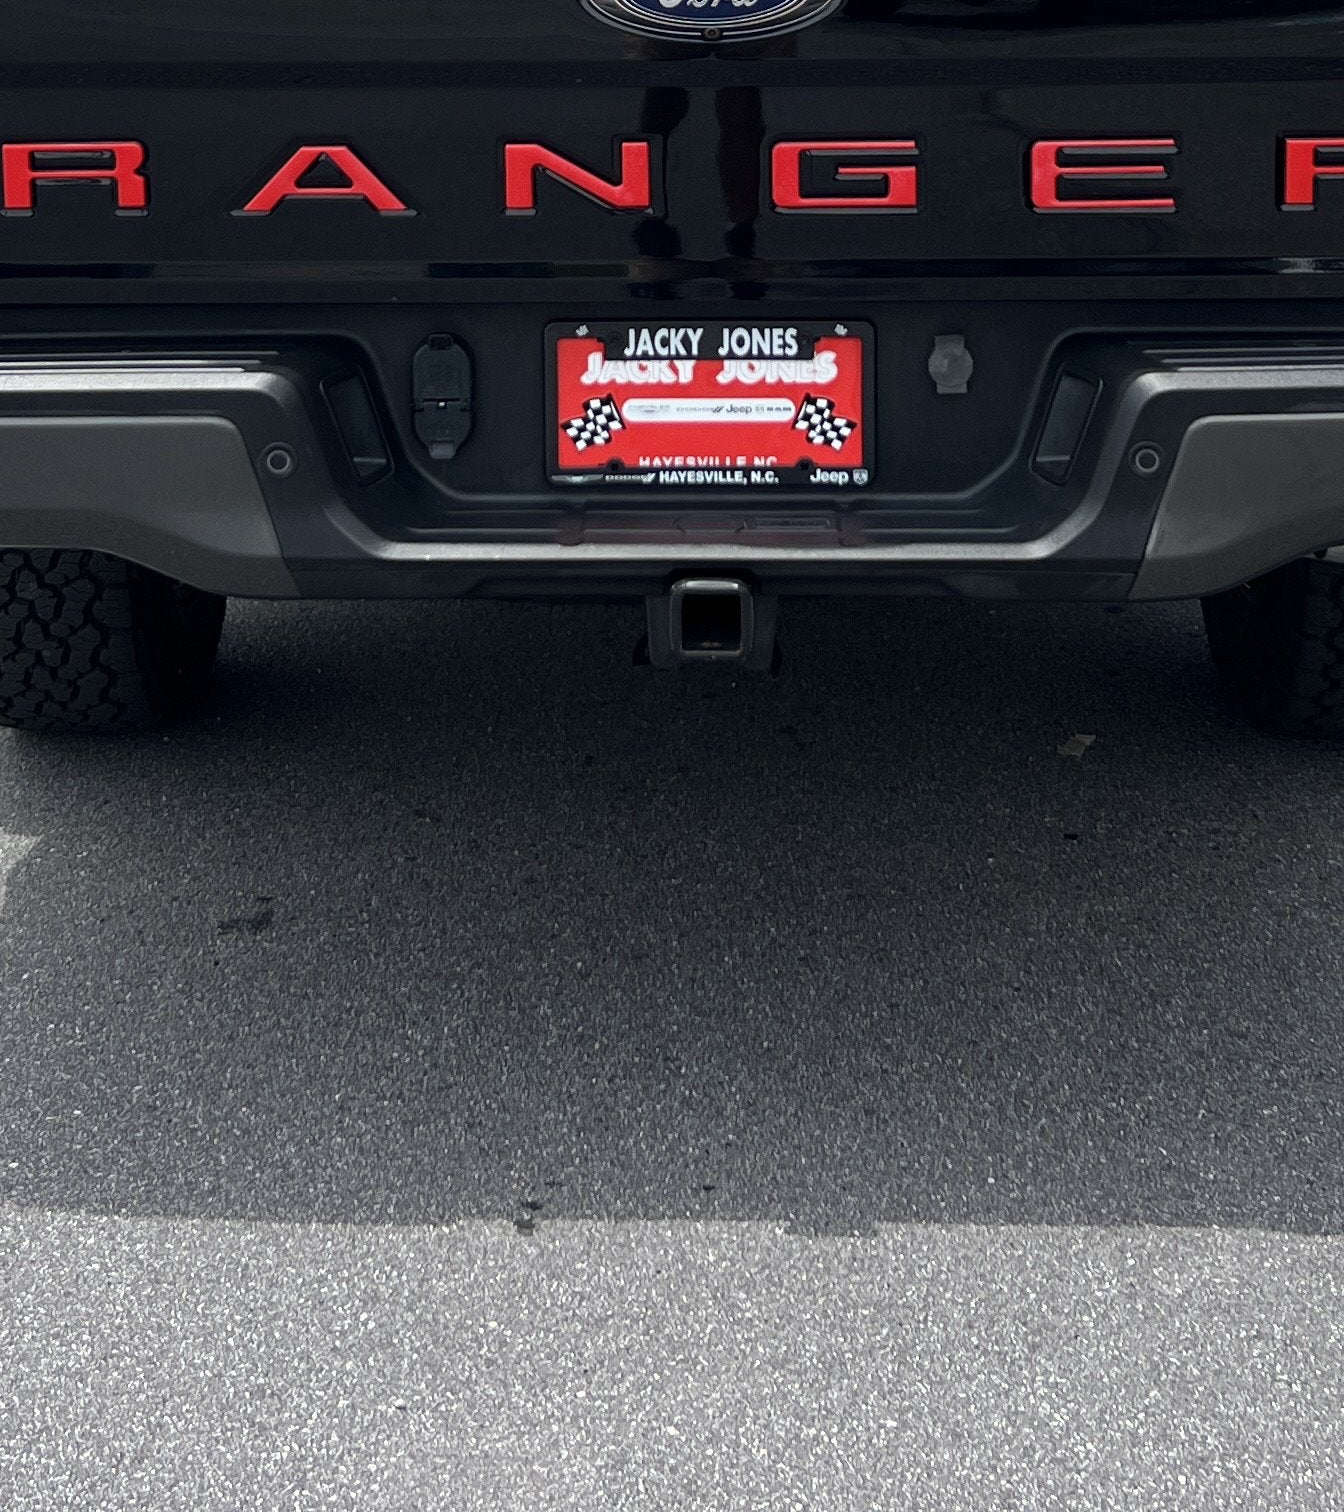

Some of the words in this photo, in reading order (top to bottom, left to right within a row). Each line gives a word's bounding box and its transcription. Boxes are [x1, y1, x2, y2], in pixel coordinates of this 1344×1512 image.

[624, 327, 704, 357] JACKY
[718, 326, 799, 356] JONES
[725, 403, 753, 415] Jeep
[659, 470, 748, 485] HAYESVILLE,
[750, 470, 780, 484] N.C.
[809, 467, 850, 485] Jeep
